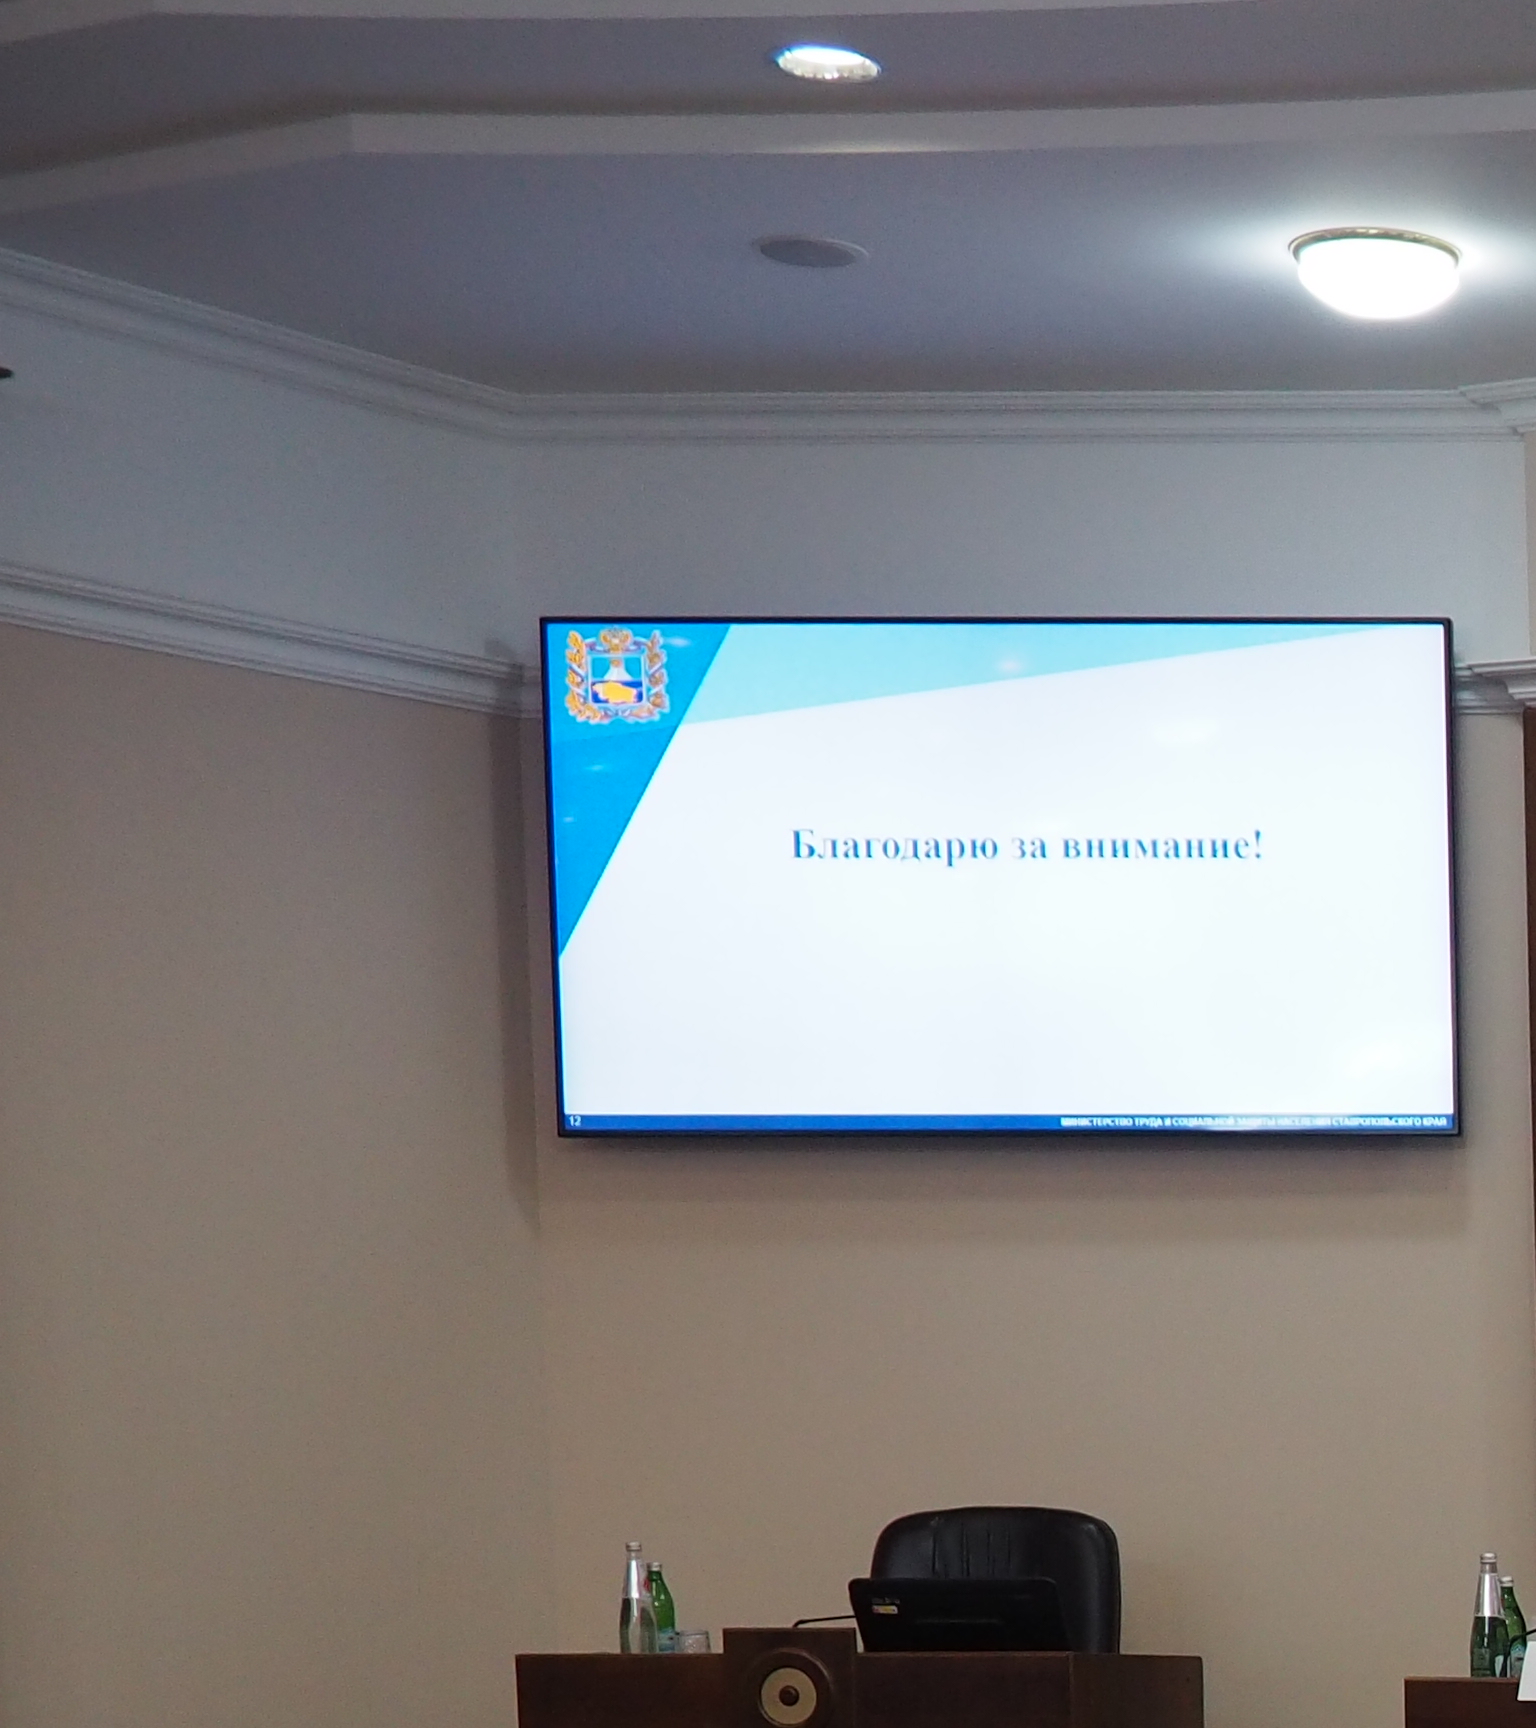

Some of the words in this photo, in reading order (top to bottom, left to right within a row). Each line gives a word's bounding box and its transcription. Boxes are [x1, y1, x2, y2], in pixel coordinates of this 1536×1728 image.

[791, 828, 999, 868] Благодарю
[1011, 835, 1049, 860] за
[1061, 829, 1264, 861] внимание!
[569, 1115, 582, 1127] 12
